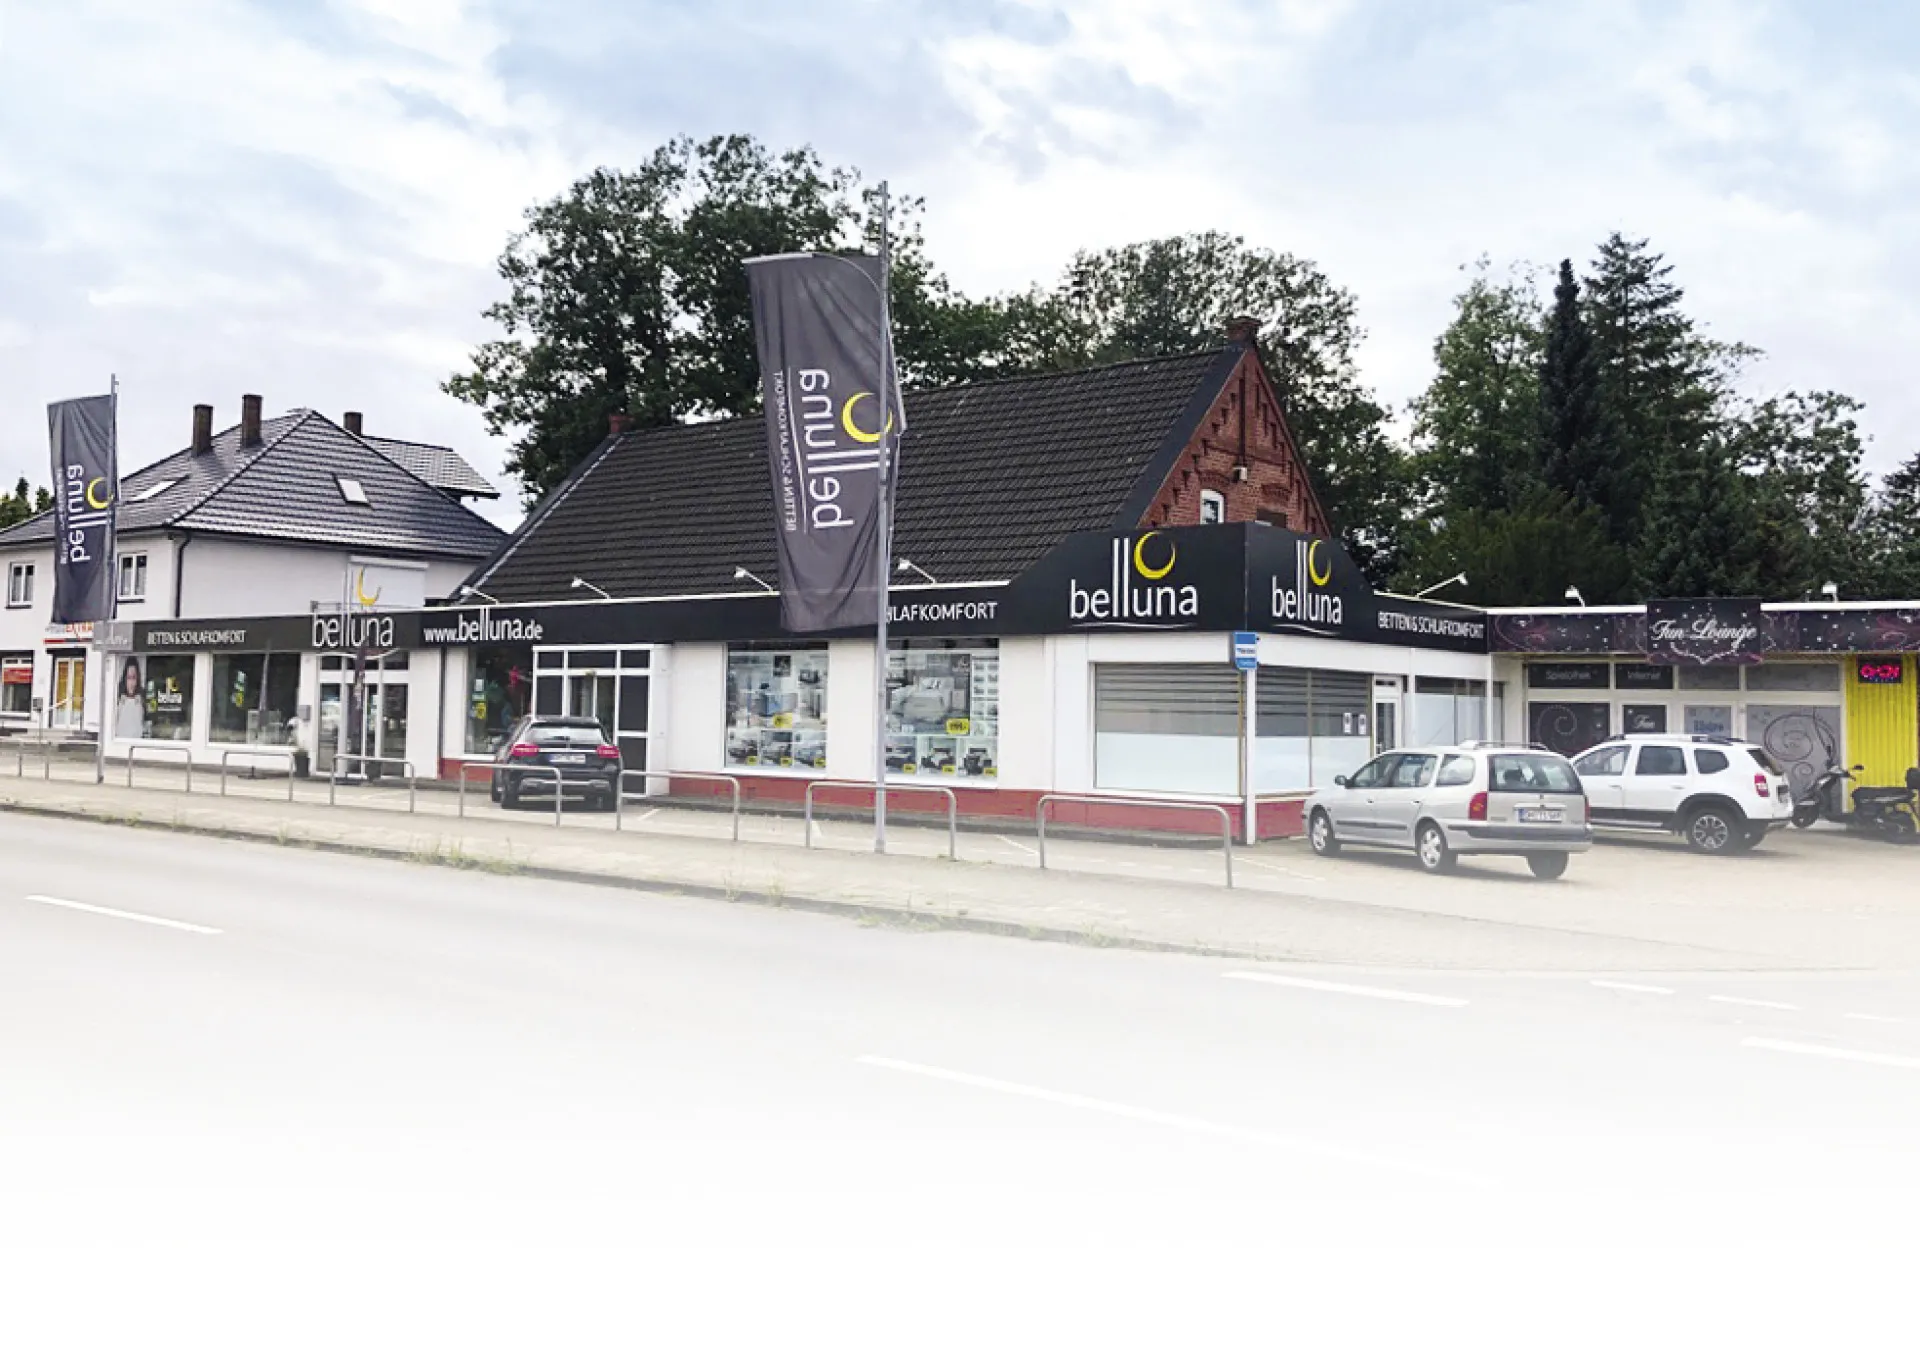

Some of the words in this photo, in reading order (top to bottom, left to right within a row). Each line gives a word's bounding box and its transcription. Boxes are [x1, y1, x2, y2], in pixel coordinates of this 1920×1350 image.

[1070, 537, 1199, 619] belluna
[1271, 540, 1342, 625] belluna
[424, 606, 543, 643] www.belluna.de
[1650, 619, 1685, 641] Fun
[1689, 617, 1758, 647] Lounge
